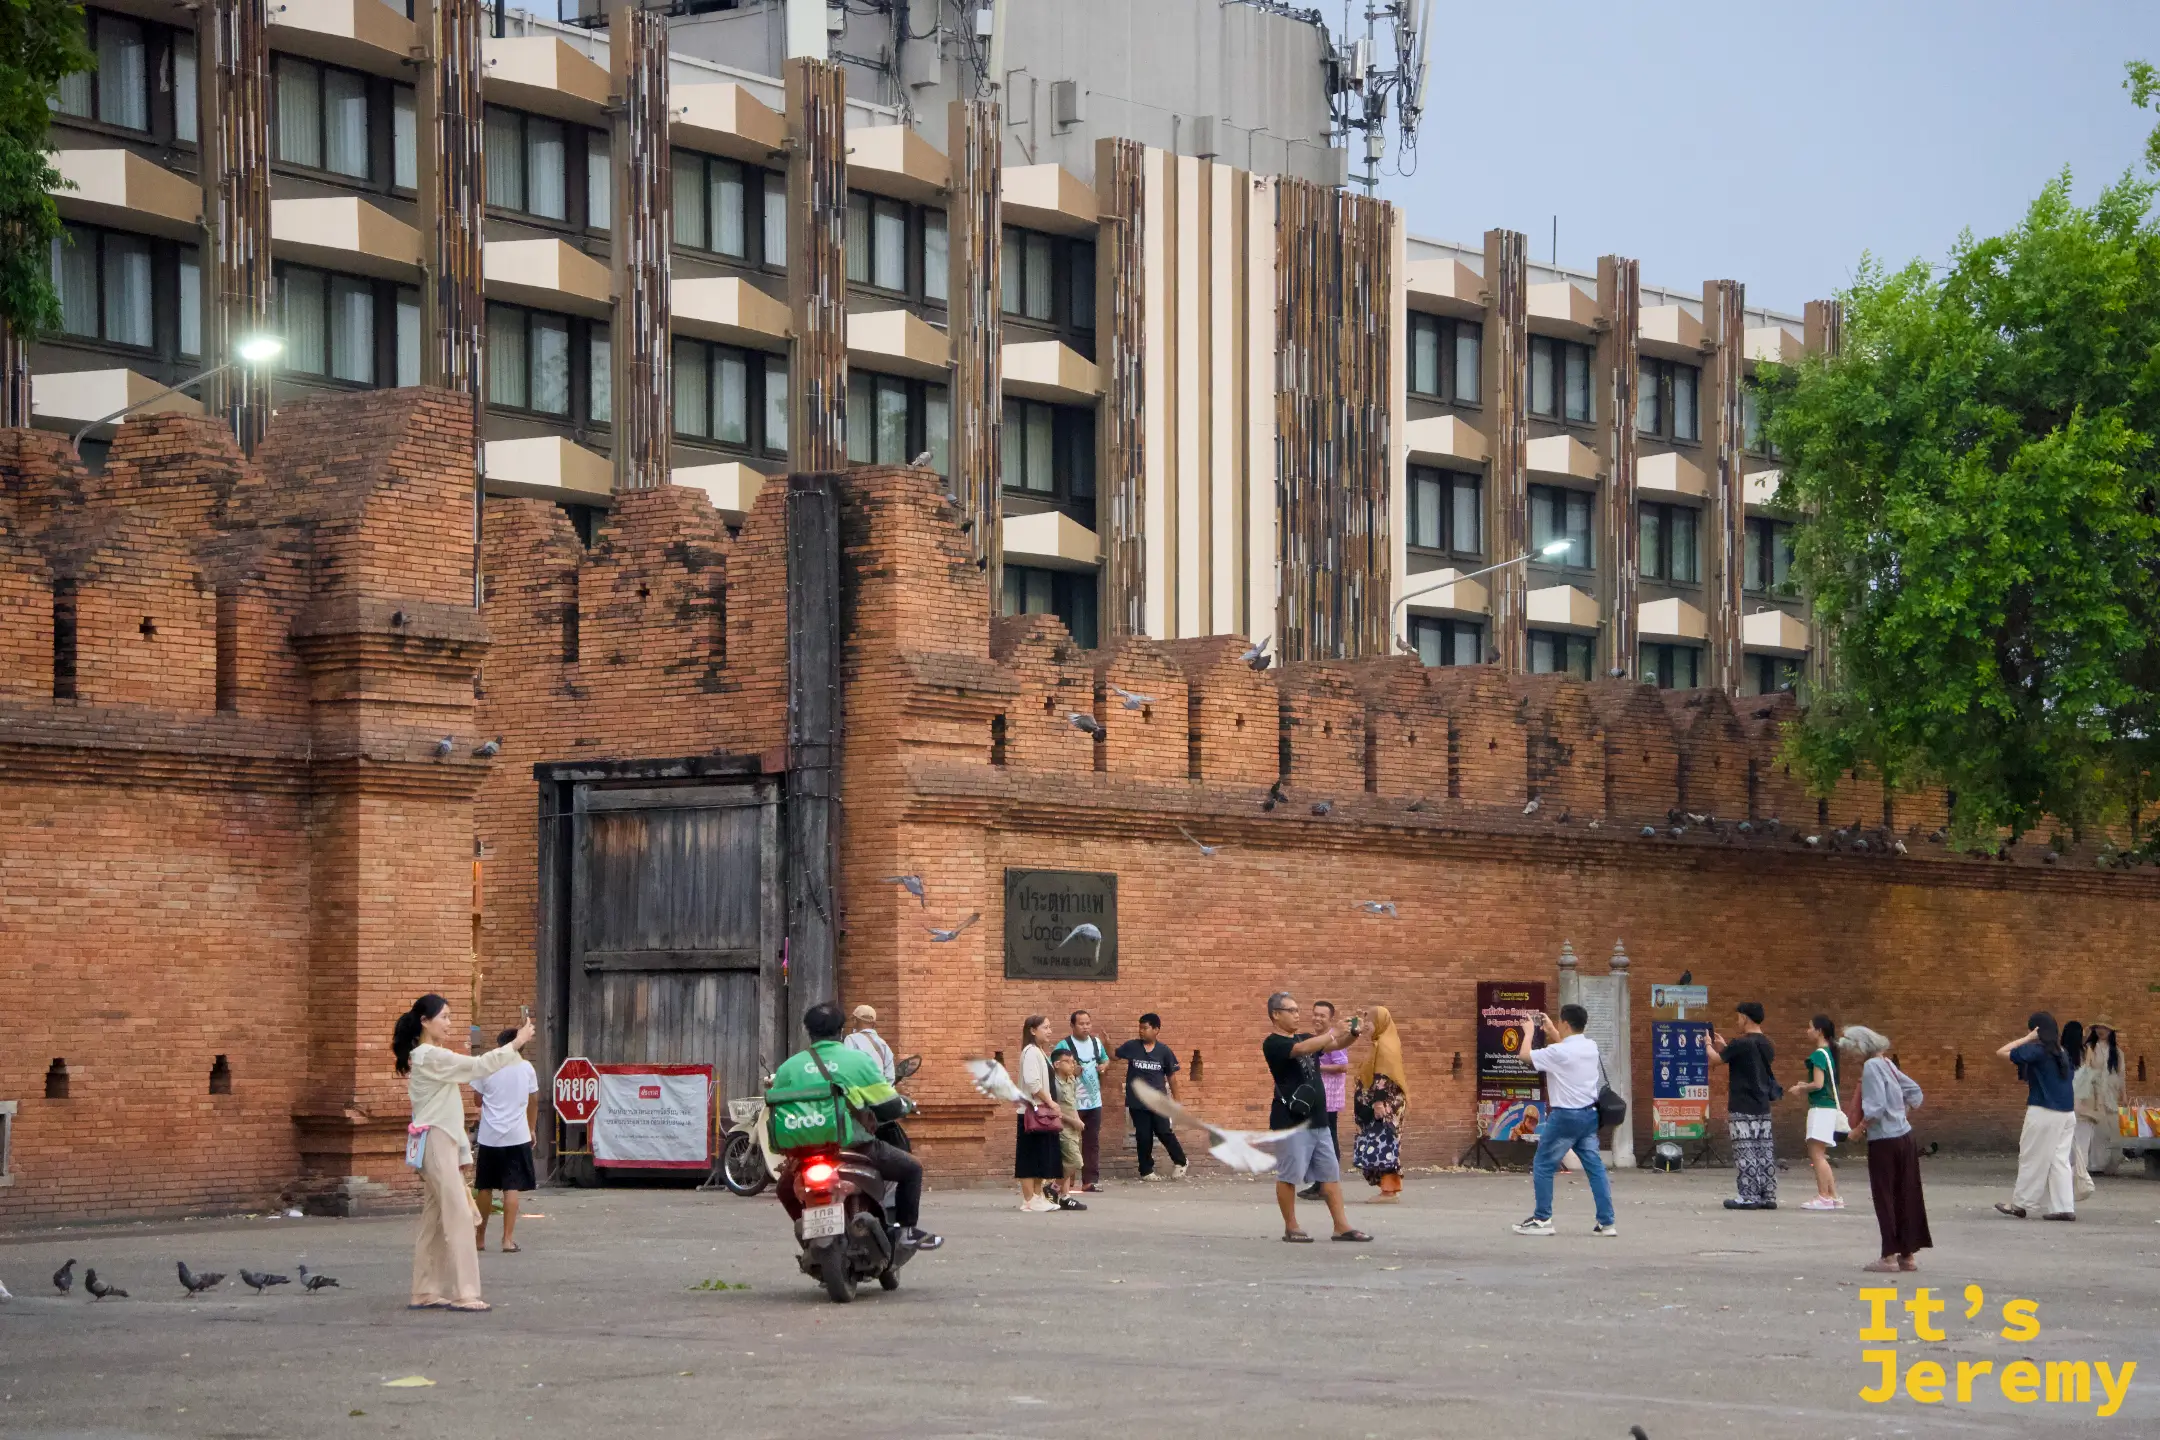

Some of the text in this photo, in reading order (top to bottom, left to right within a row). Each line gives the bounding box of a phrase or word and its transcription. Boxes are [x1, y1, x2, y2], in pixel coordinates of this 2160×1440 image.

[1019, 886, 1104, 922] ประตูท่าแพ
[1525, 992, 1530, 1001] 5
[804, 1061, 839, 1074] Grb
[556, 1078, 598, 1115] หยุด
[1687, 1087, 1708, 1098] 1155
[785, 1111, 826, 1129] Grab
